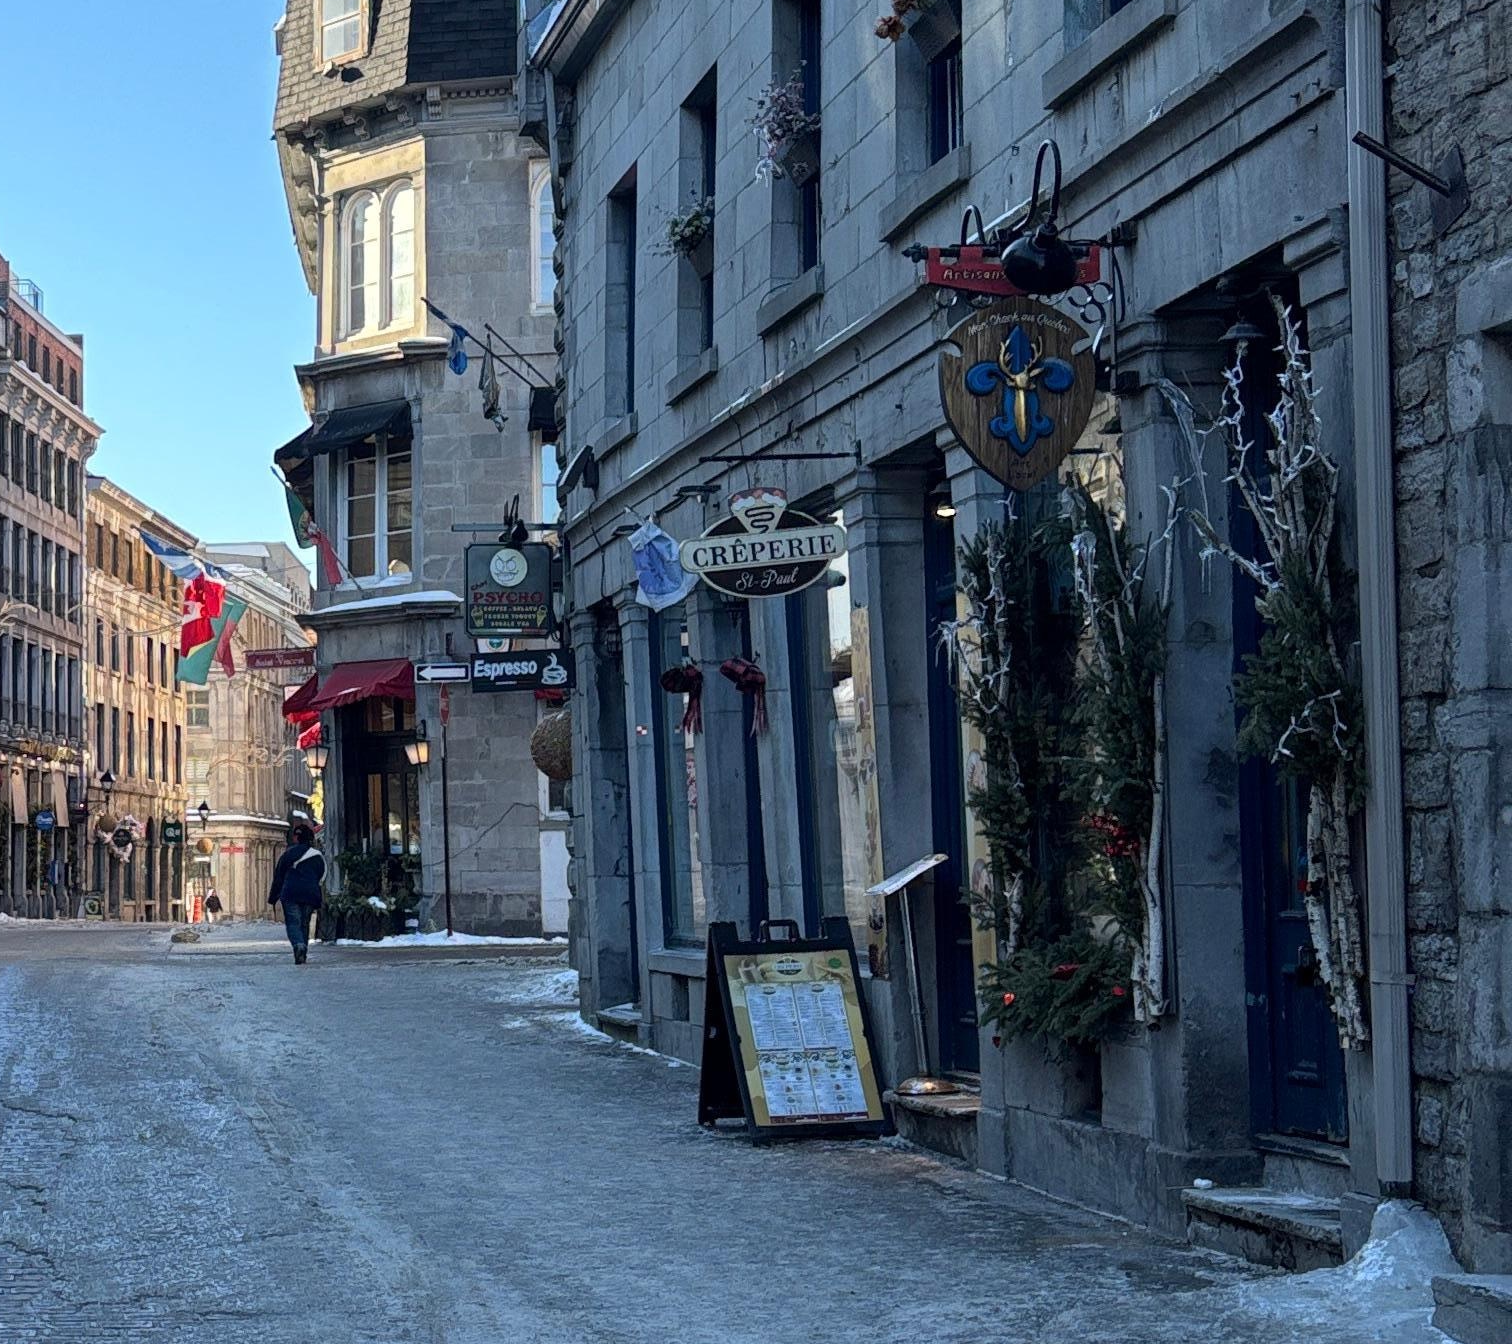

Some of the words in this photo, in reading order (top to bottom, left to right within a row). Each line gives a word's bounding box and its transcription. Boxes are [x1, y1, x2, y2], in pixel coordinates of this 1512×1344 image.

[943, 268, 1006, 281] Artisans
[692, 534, 837, 568] CRÊPERIE
[736, 565, 800, 592] St-Paul
[473, 591, 545, 604] PSYCHO
[473, 659, 538, 681] Espresso
